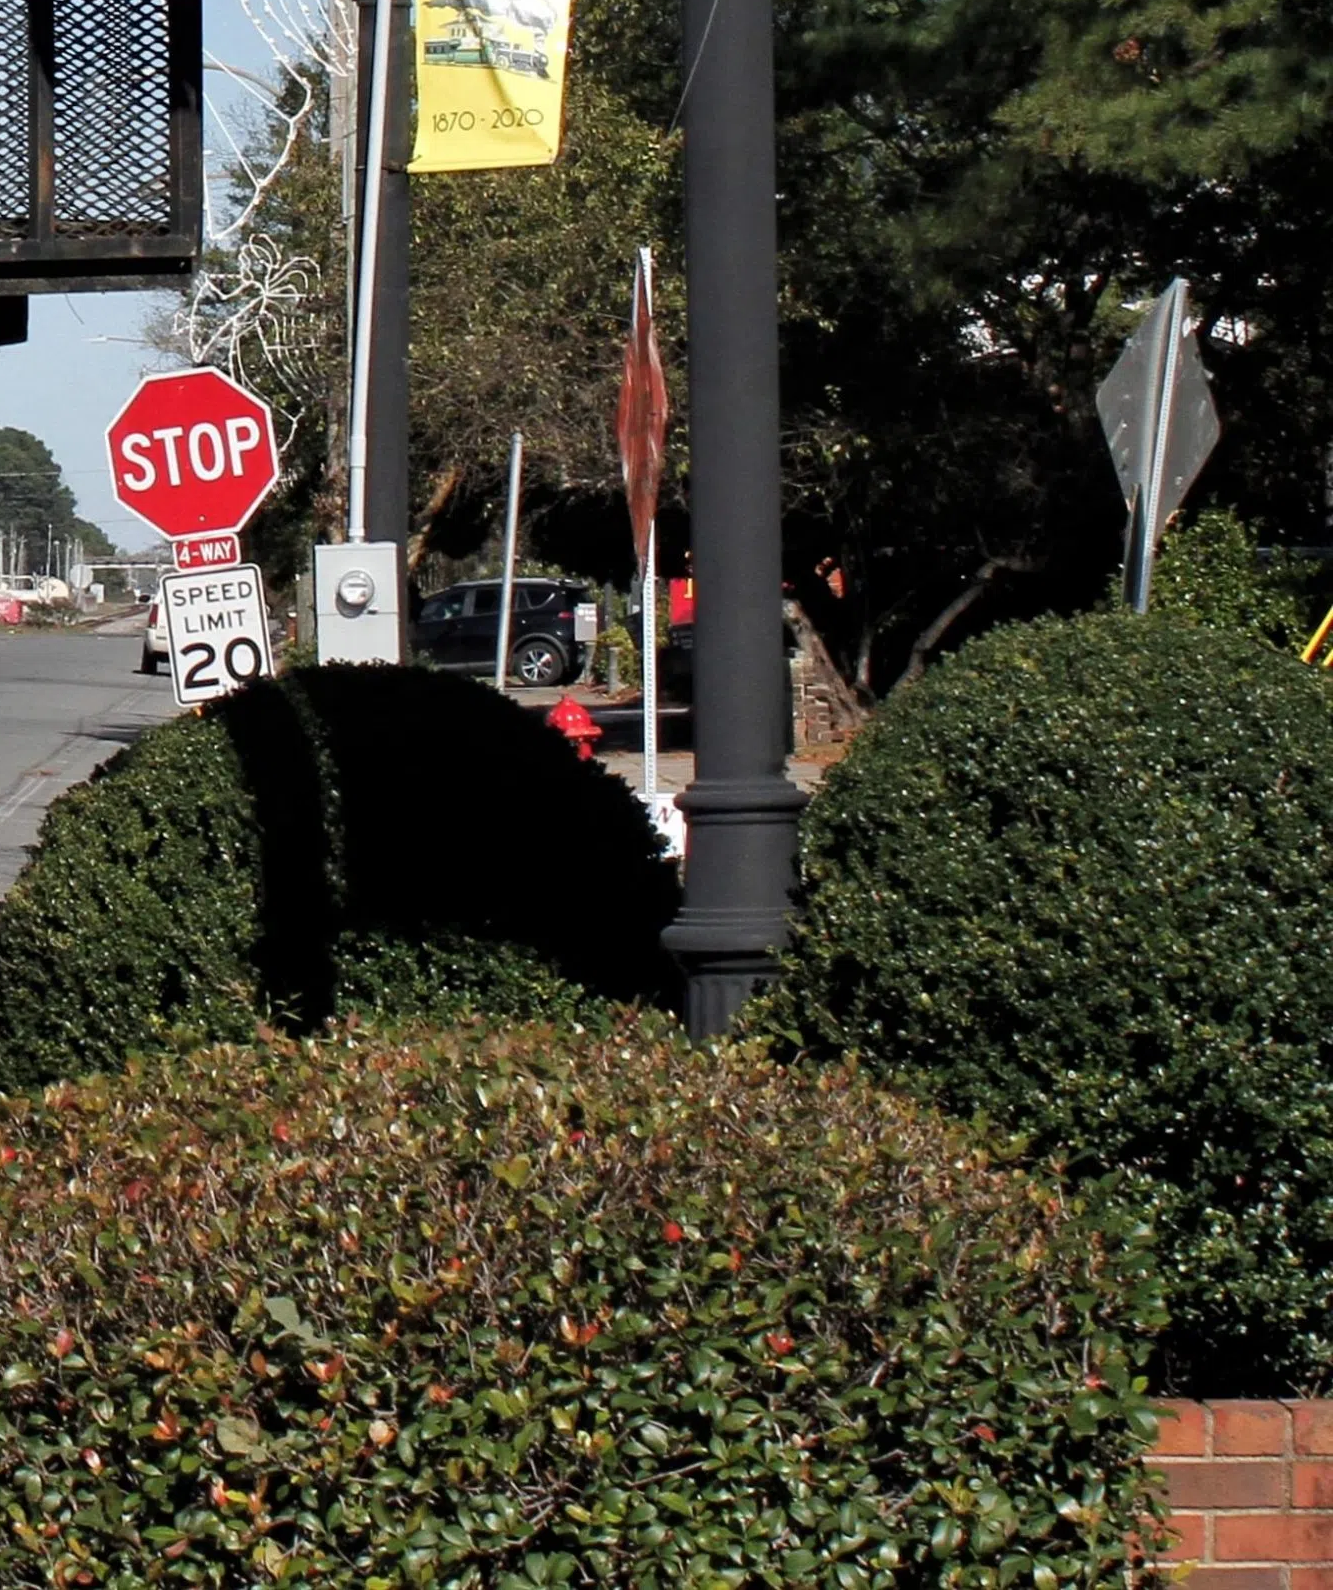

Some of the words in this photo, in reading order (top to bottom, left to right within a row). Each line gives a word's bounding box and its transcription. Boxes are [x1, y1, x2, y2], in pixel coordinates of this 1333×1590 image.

[432, 111, 475, 133] 1870
[491, 108, 544, 129] 2020
[120, 416, 261, 492] STOP
[178, 540, 234, 565] 4-WAY
[172, 581, 253, 607] SPEED
[184, 610, 247, 634] LIMIT
[180, 636, 262, 690] 20
